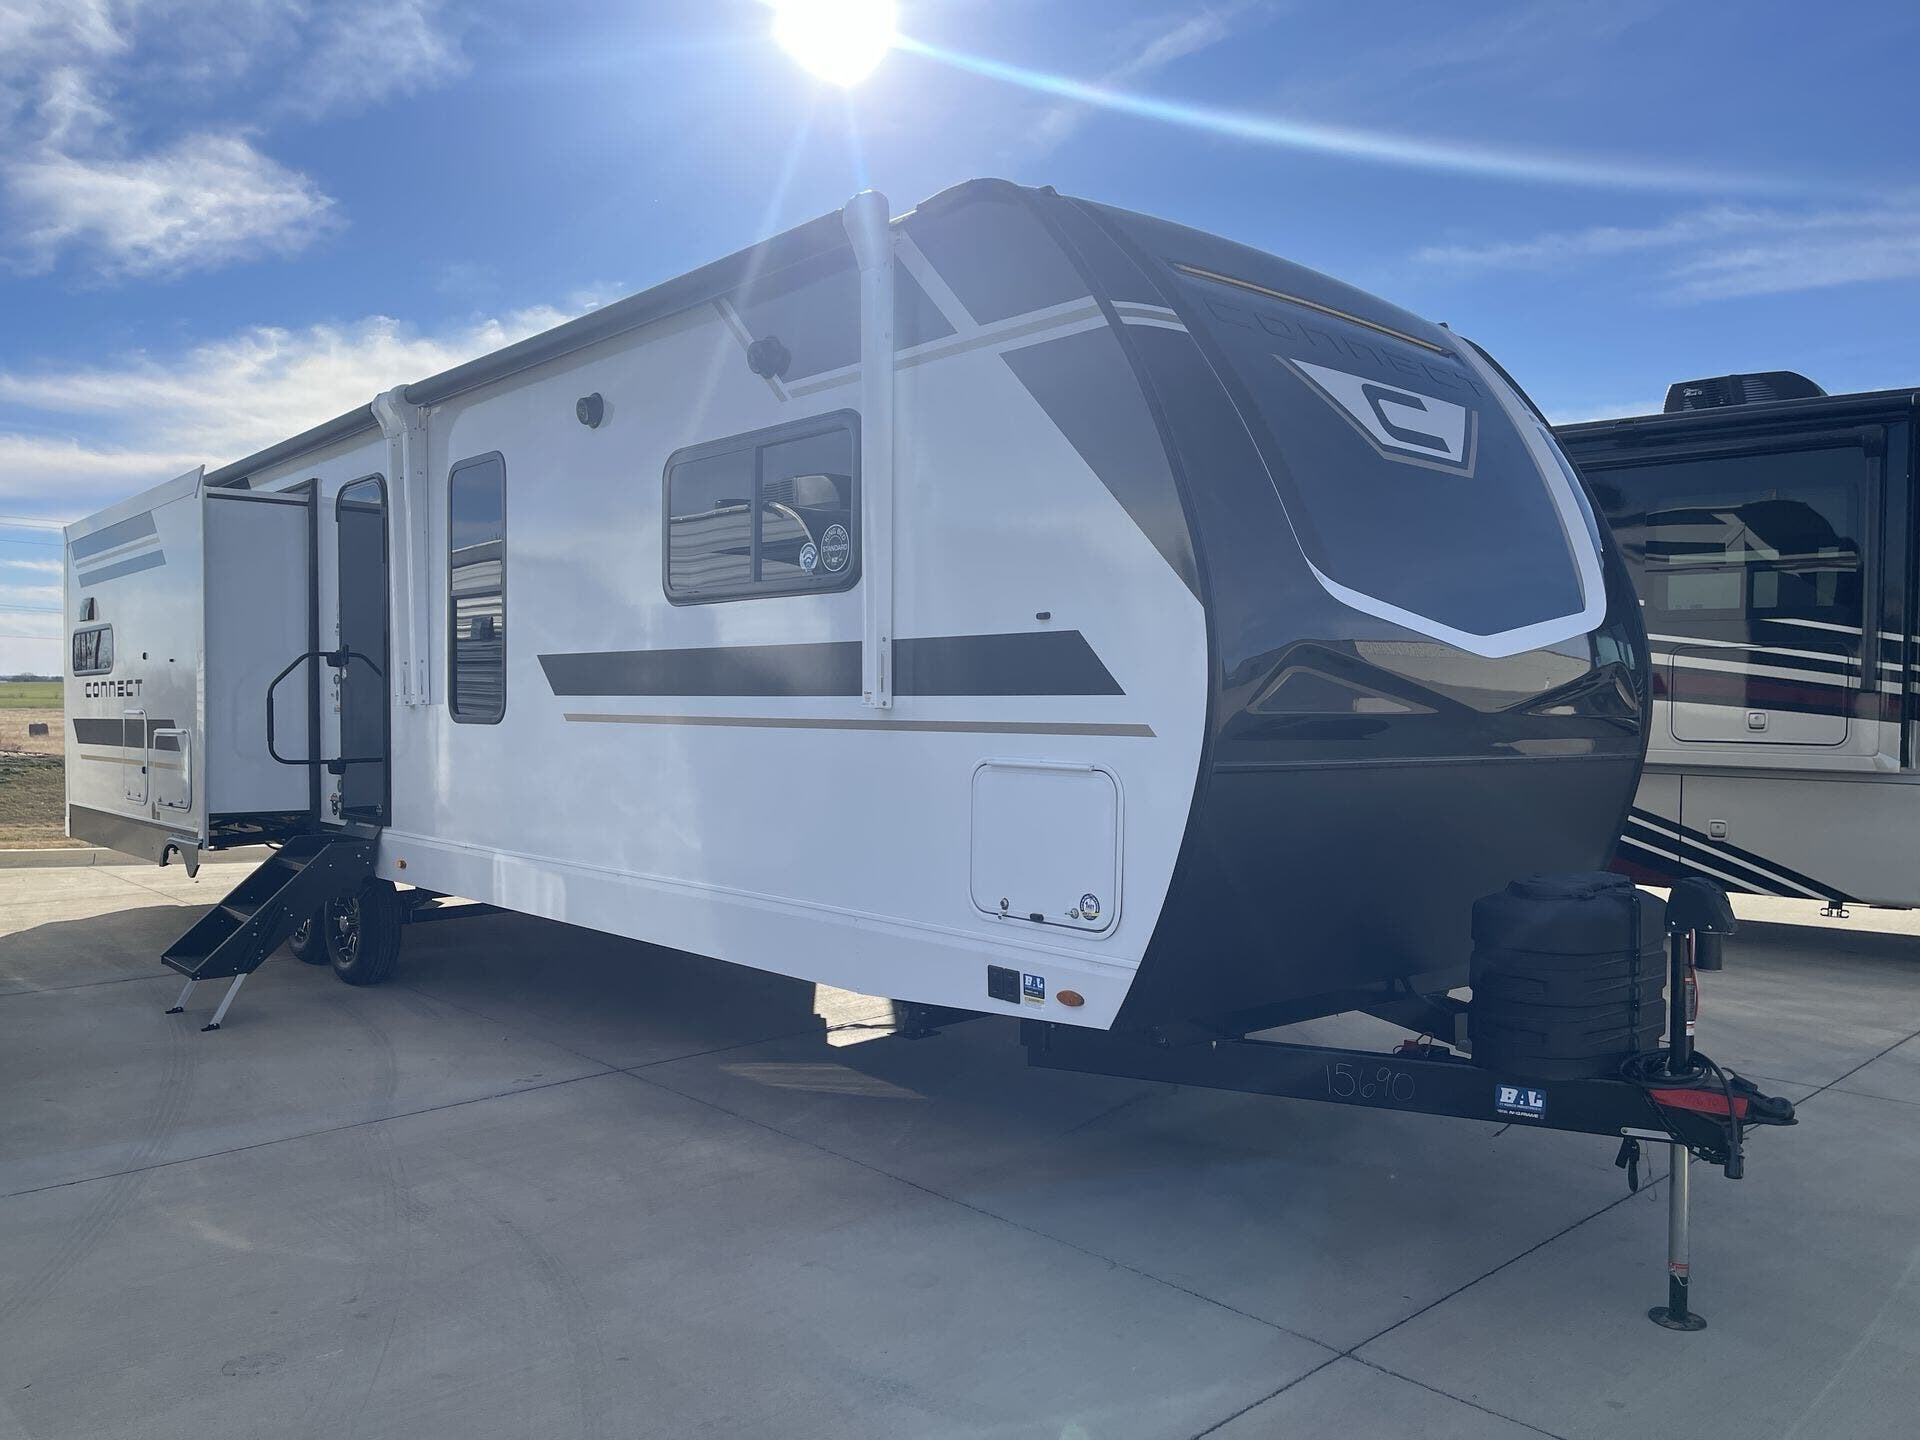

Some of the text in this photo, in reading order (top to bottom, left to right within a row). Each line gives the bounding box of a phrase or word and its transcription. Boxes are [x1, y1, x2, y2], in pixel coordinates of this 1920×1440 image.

[86, 679, 143, 697] CONNECT
[1325, 1063, 1415, 1101] 15690
[1499, 1087, 1543, 1107] BAL
